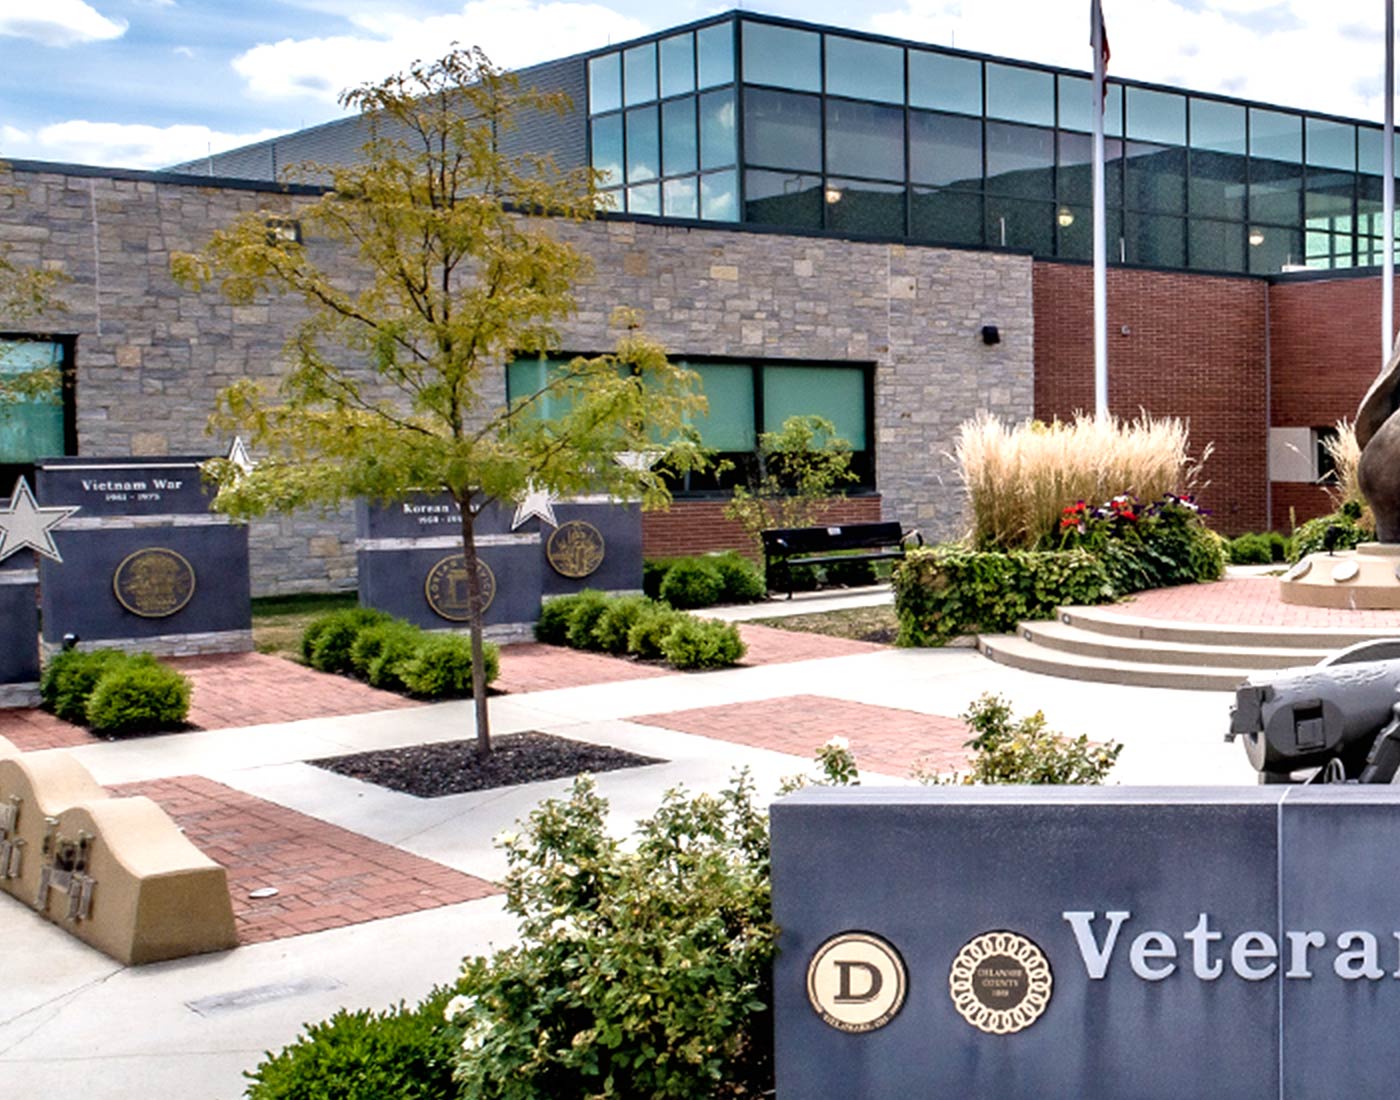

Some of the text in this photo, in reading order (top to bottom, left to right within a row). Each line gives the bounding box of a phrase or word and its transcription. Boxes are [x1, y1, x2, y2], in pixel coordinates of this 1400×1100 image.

[82, 479, 183, 491] Vietnam War
[402, 503, 450, 514] Korean
[833, 960, 883, 1001] D
[981, 979, 1020, 988] COUNTY
